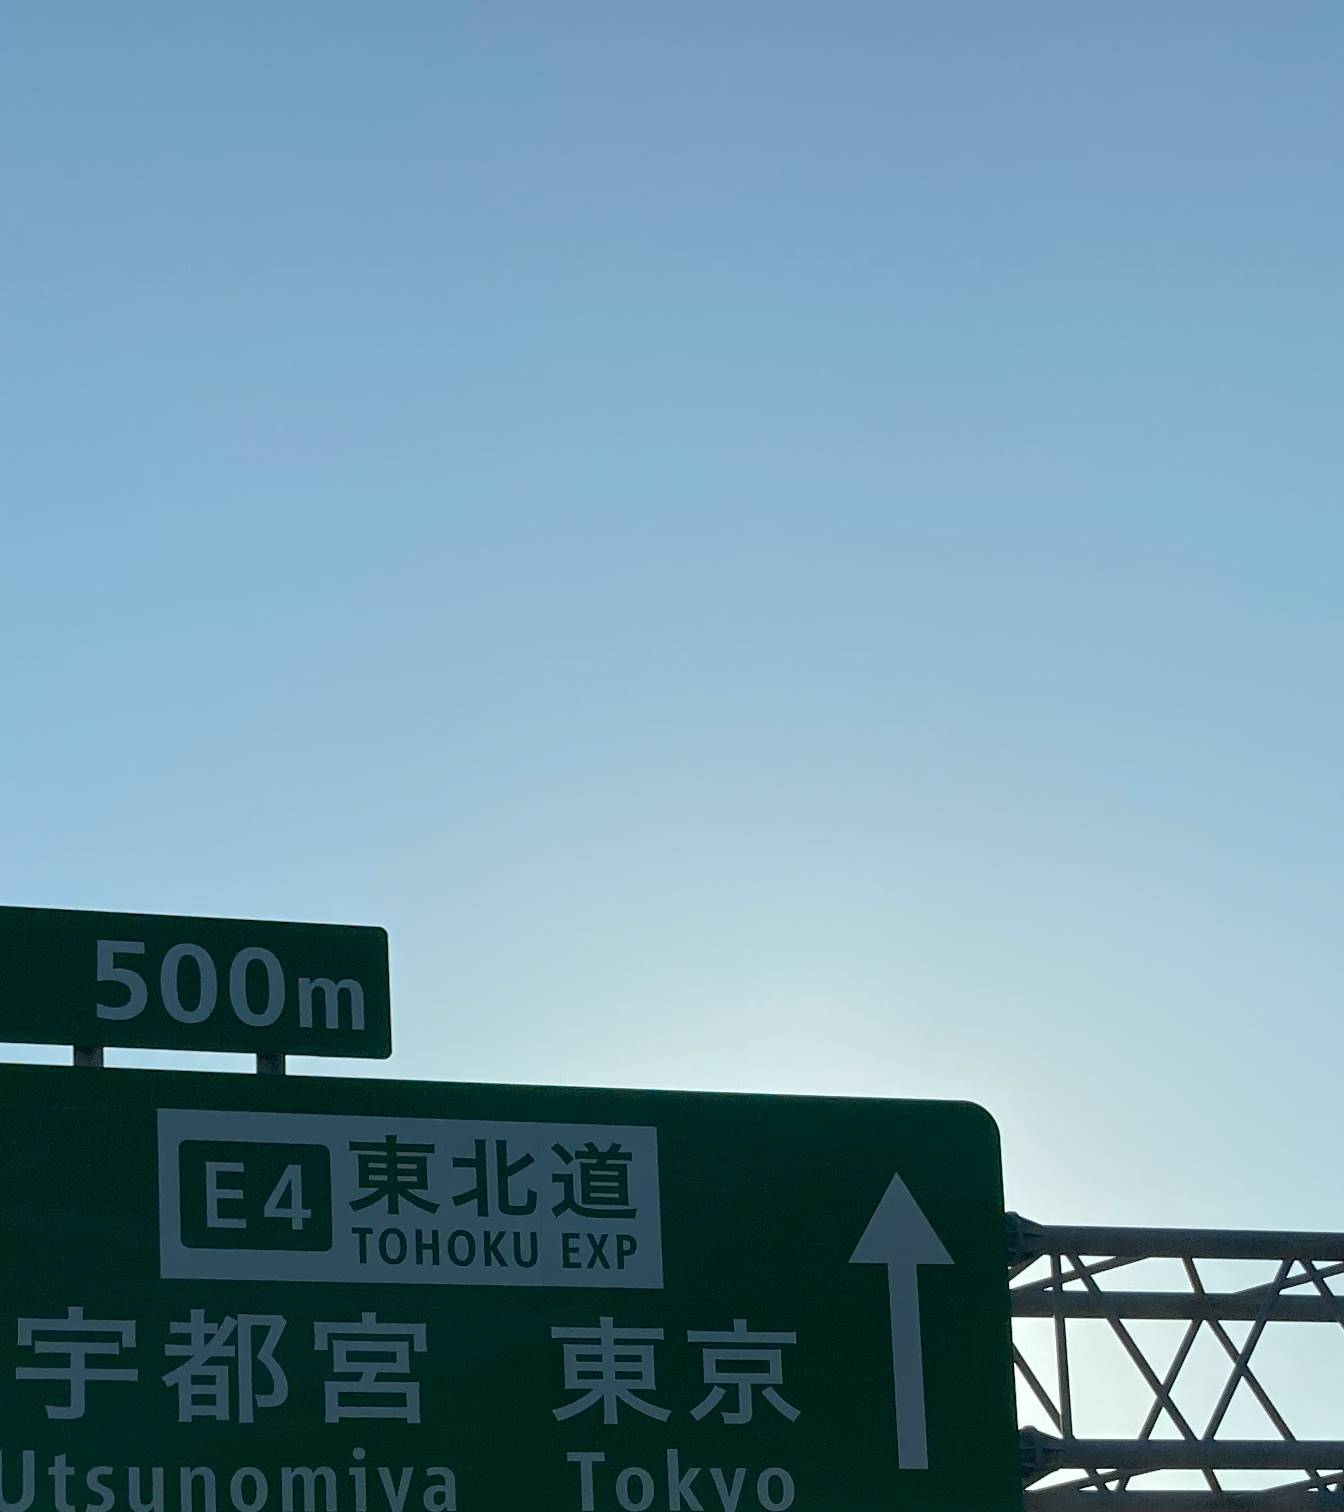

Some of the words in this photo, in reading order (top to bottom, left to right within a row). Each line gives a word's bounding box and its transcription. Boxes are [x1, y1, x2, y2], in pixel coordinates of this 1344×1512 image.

[97, 940, 364, 1030] 500m
[206, 1161, 312, 1231] E4
[348, 1134, 638, 1219] 東北道
[351, 1226, 539, 1269] TOHOKU
[561, 1232, 638, 1270] EXP
[15, 1305, 428, 1424] 宇都宮
[550, 1315, 802, 1425] 東京
